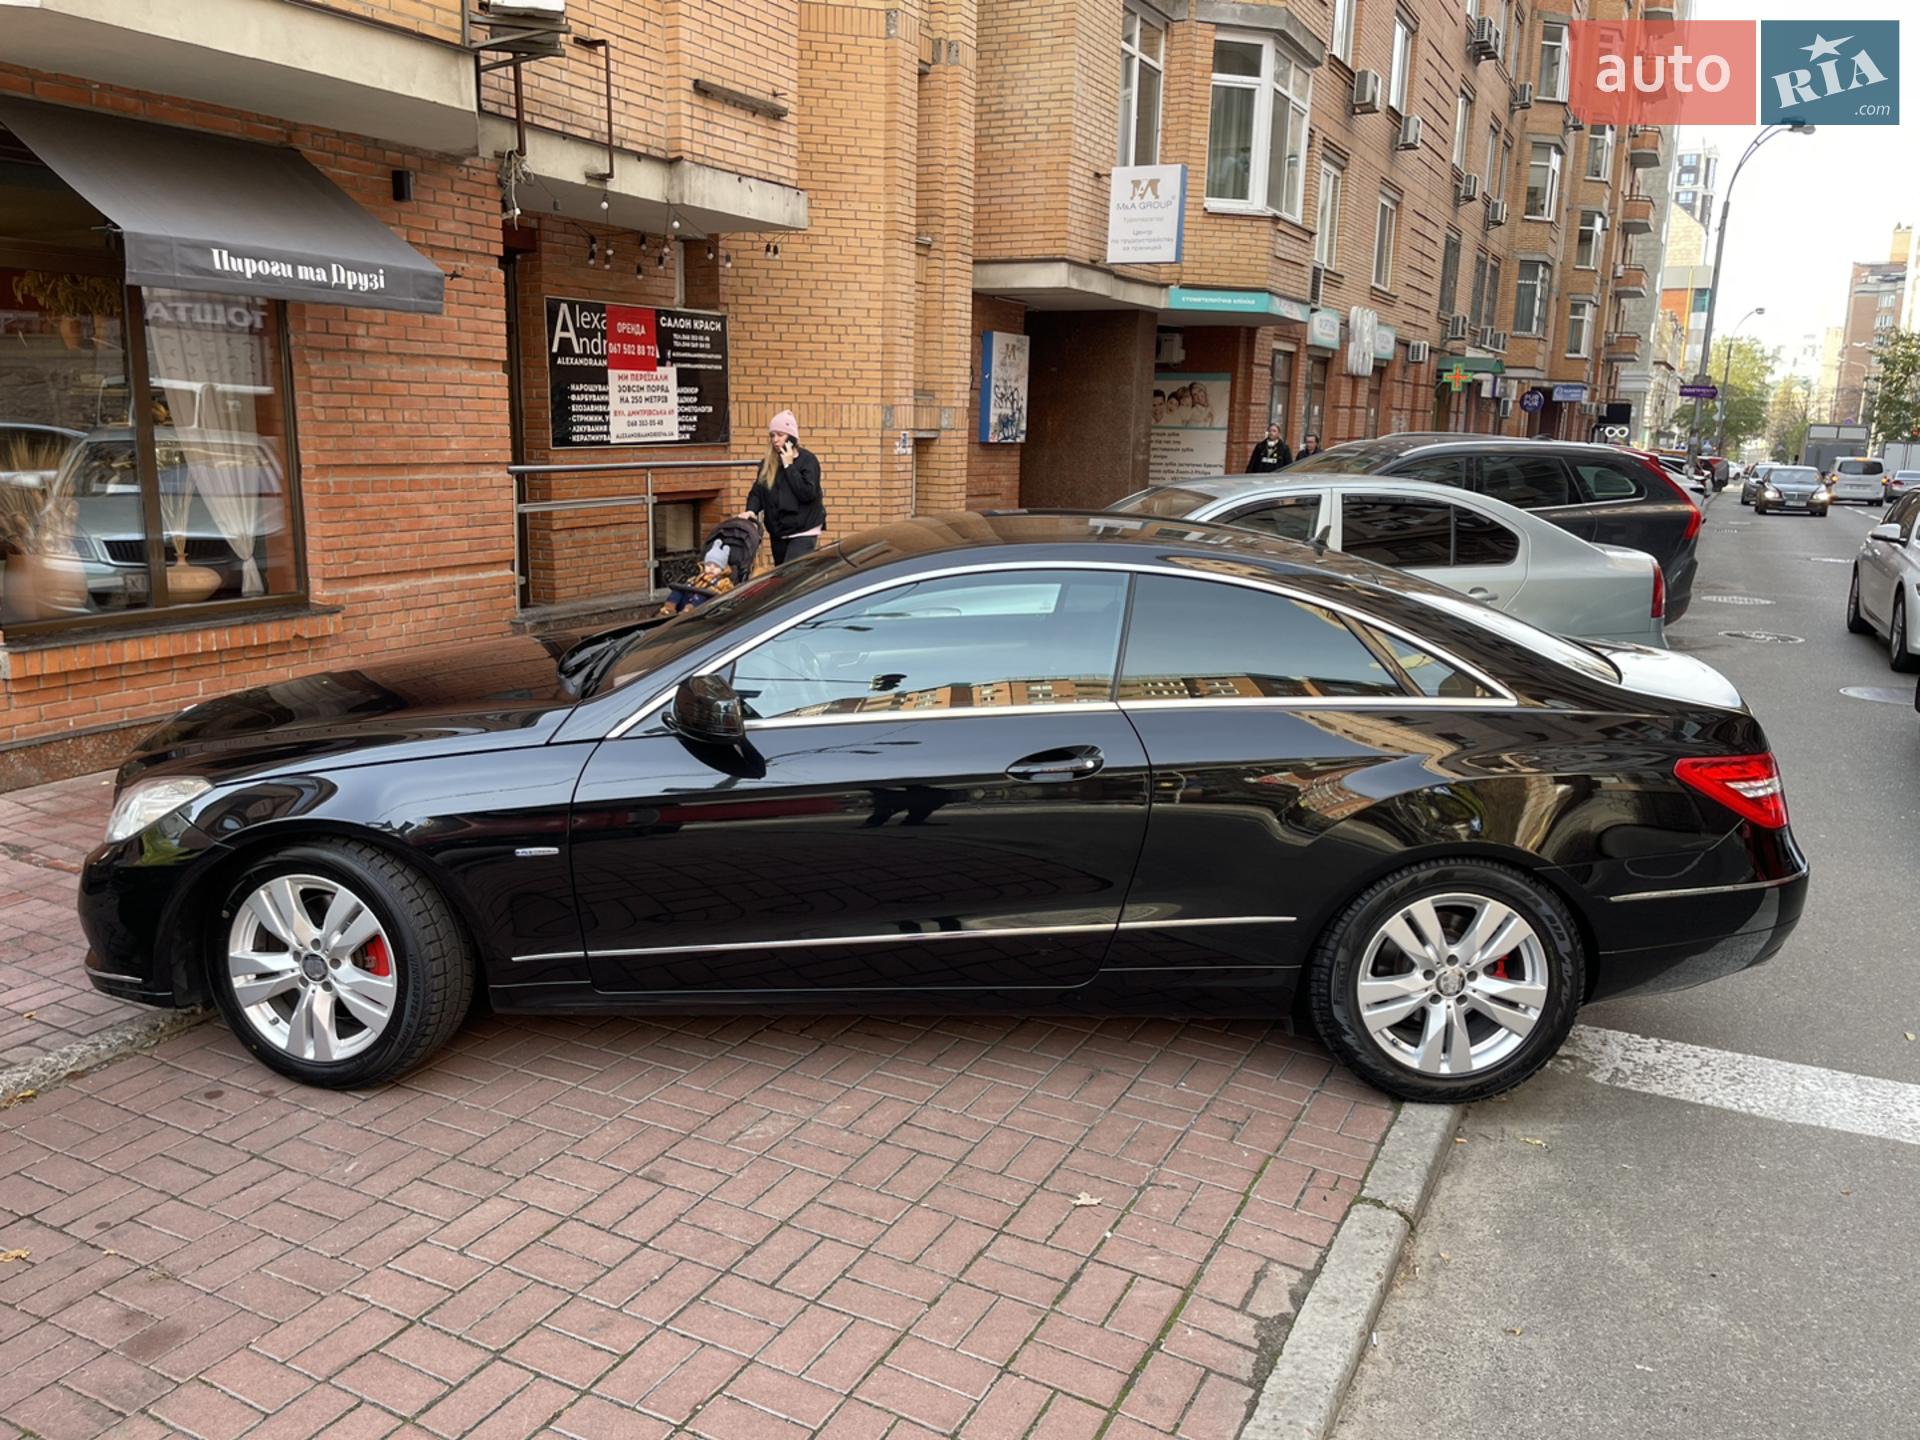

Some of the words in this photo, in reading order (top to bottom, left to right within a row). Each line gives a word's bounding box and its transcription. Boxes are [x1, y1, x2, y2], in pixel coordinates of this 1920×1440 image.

[1138, 200, 1173, 210] GROUP
[210, 247, 293, 279] Пироги
[298, 265, 327, 282] та
[330, 263, 386, 292] Друзі
[616, 322, 646, 336] ОРЕНДА
[660, 316, 692, 330] САЛОН
[693, 318, 722, 332] КРАСИ
[608, 342, 621, 354] 067
[623, 343, 635, 355] 502
[646, 344, 655, 357] 72
[557, 356, 607, 366] ALEXANDRAAN
[618, 374, 628, 382] МИ
[630, 372, 668, 382] ПЕРЕЇХАЛИ
[617, 384, 645, 393] ЗОВСІМ
[620, 395, 629, 404] НА
[631, 395, 643, 404] 250
[644, 395, 668, 404] МЕТРІВ
